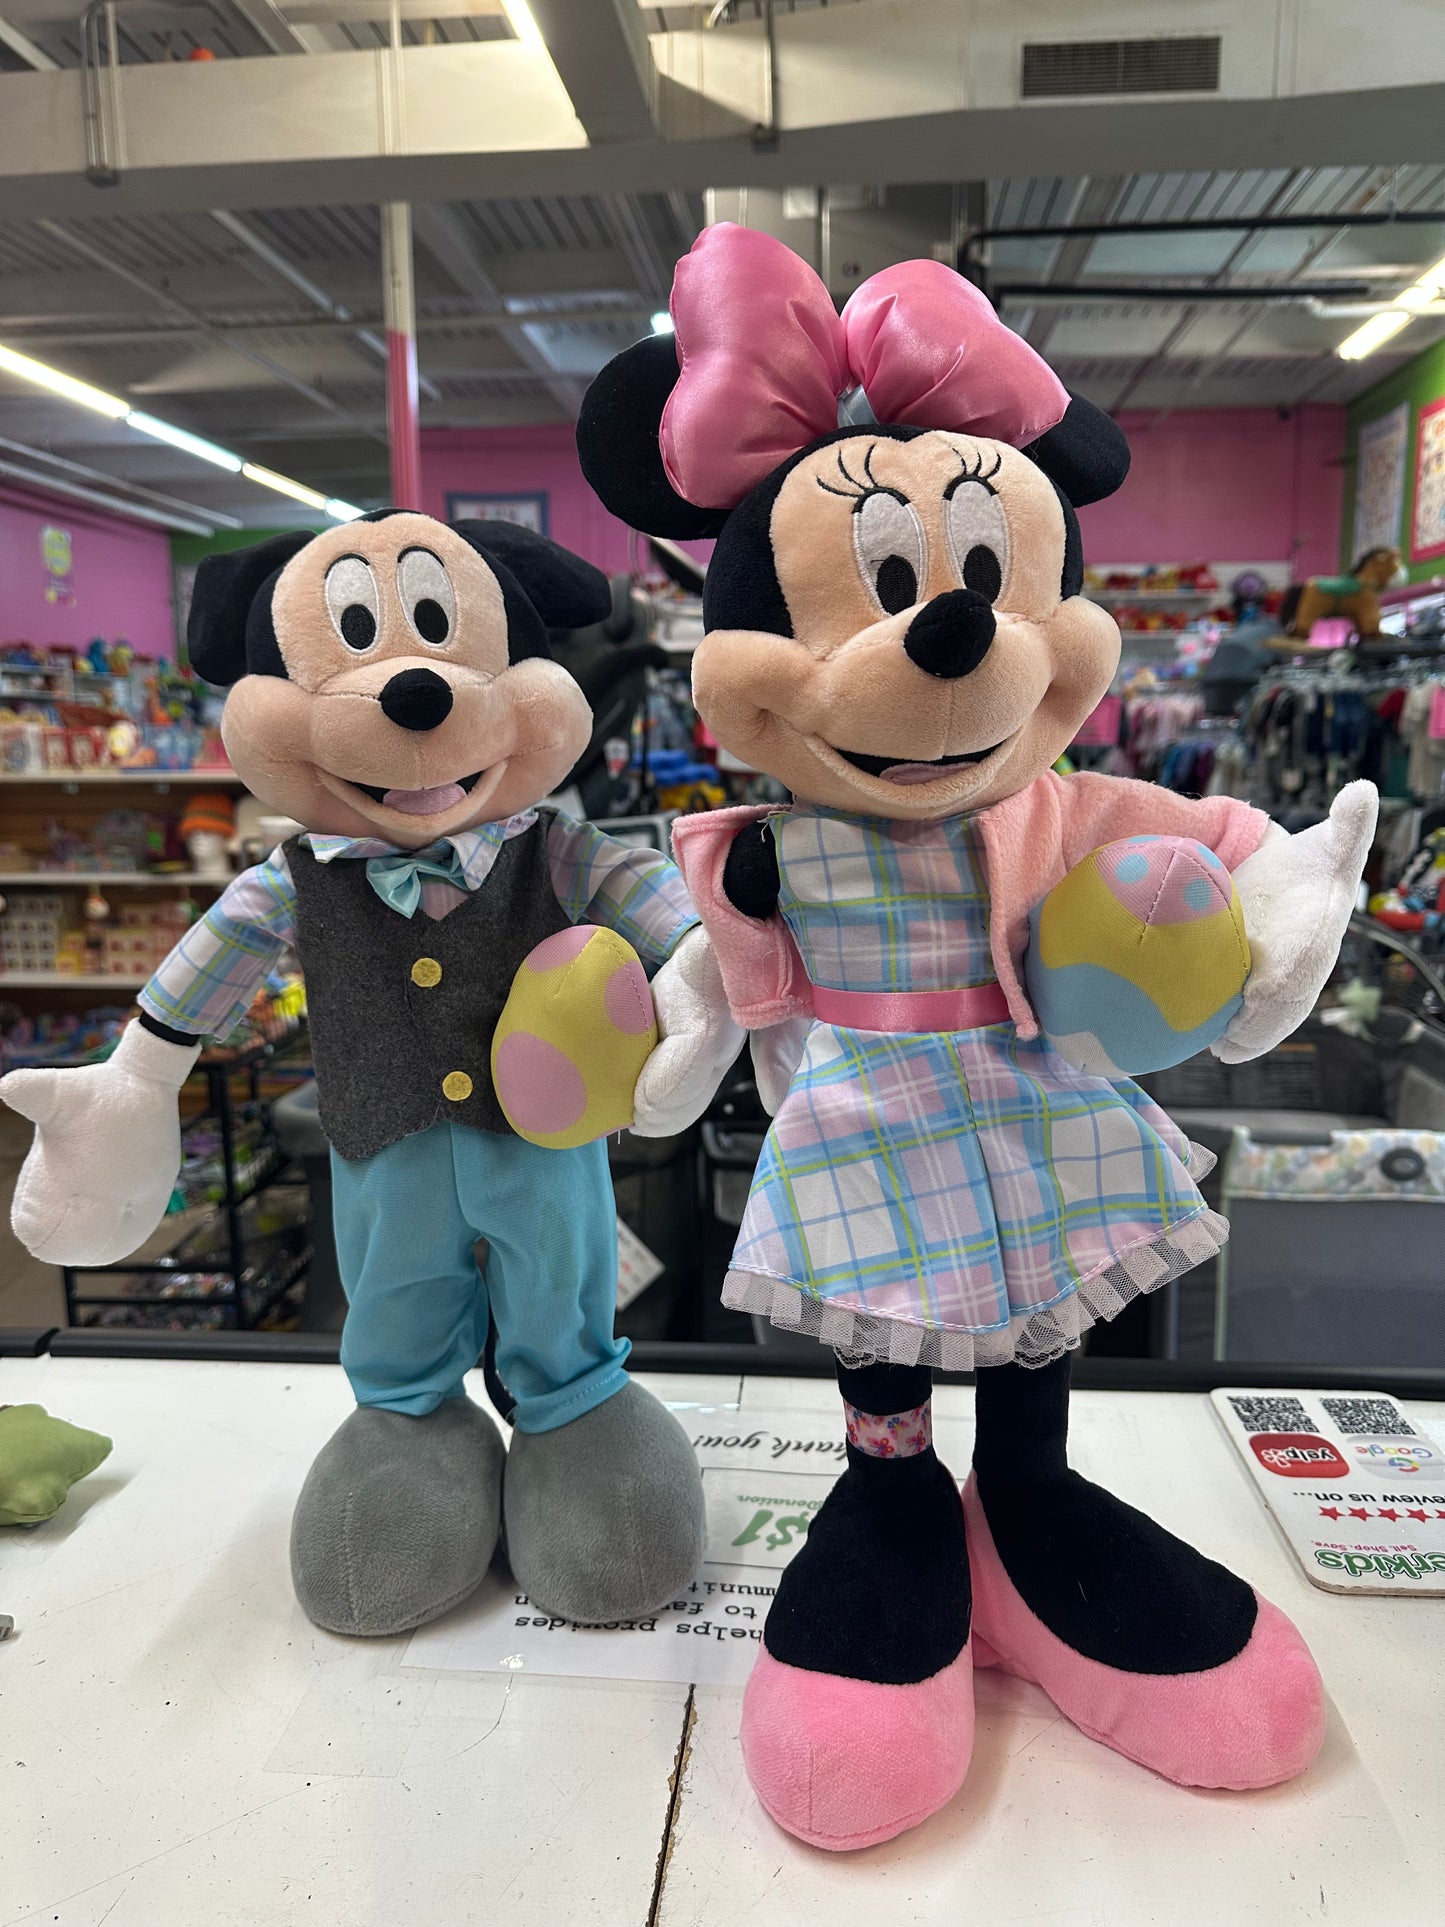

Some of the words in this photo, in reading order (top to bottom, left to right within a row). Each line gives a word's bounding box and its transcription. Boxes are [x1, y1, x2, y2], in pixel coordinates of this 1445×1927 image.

[693, 1431, 769, 1448] you!
[771, 1437, 848, 1461] hank
[1286, 1447, 1336, 1462] yelp
[1354, 1444, 1433, 1459] Google
[736, 1495, 822, 1511] Donation
[1348, 1493, 1377, 1503] us
[1382, 1494, 1445, 1506] eview
[731, 1509, 810, 1552] $1
[1311, 1541, 1347, 1551] Save.
[1349, 1544, 1388, 1552] Shop.
[688, 1582, 775, 1596] munit
[724, 1605, 757, 1621] to
[676, 1622, 764, 1643] helps
